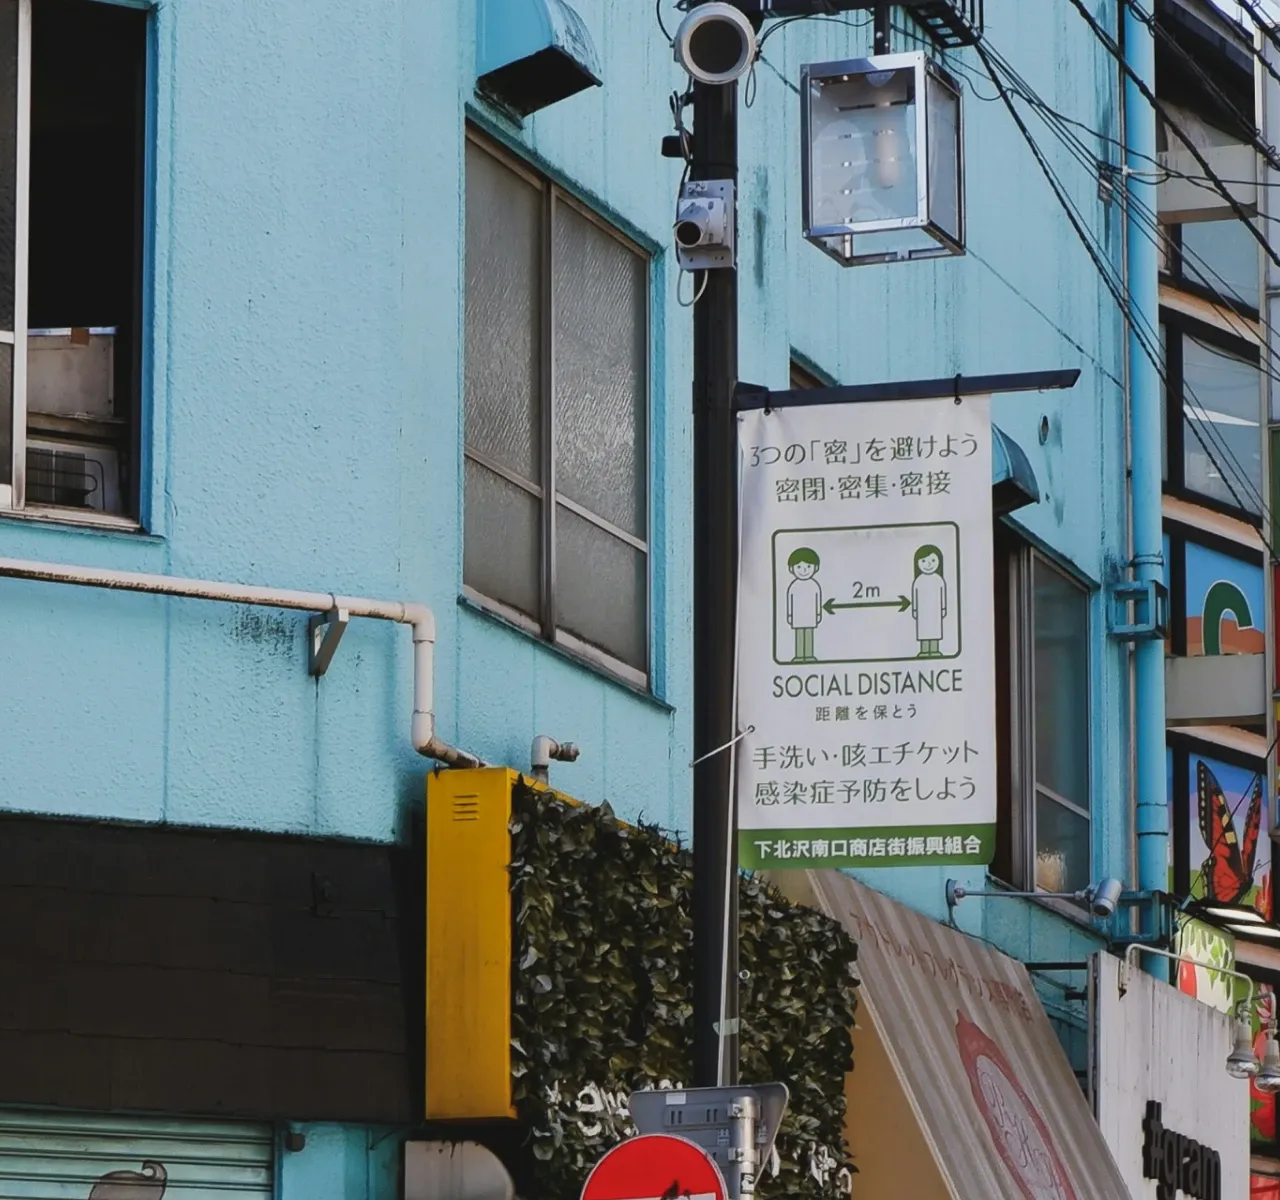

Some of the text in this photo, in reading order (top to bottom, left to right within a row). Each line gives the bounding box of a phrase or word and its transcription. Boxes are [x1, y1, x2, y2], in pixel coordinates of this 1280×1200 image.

[750, 432, 979, 468] 3つの「密」を避けよう
[775, 469, 952, 503] 密閉・密集・密接
[852, 580, 881, 600] 2m
[772, 669, 963, 699] SOCIAL DISTANCE
[815, 704, 918, 723] 距離を保とう
[752, 739, 980, 771] 手洗い・咳エチケット
[755, 775, 977, 807] 感染症予防をしよう
[754, 835, 983, 861] 下北沢南口商店街振興組合
